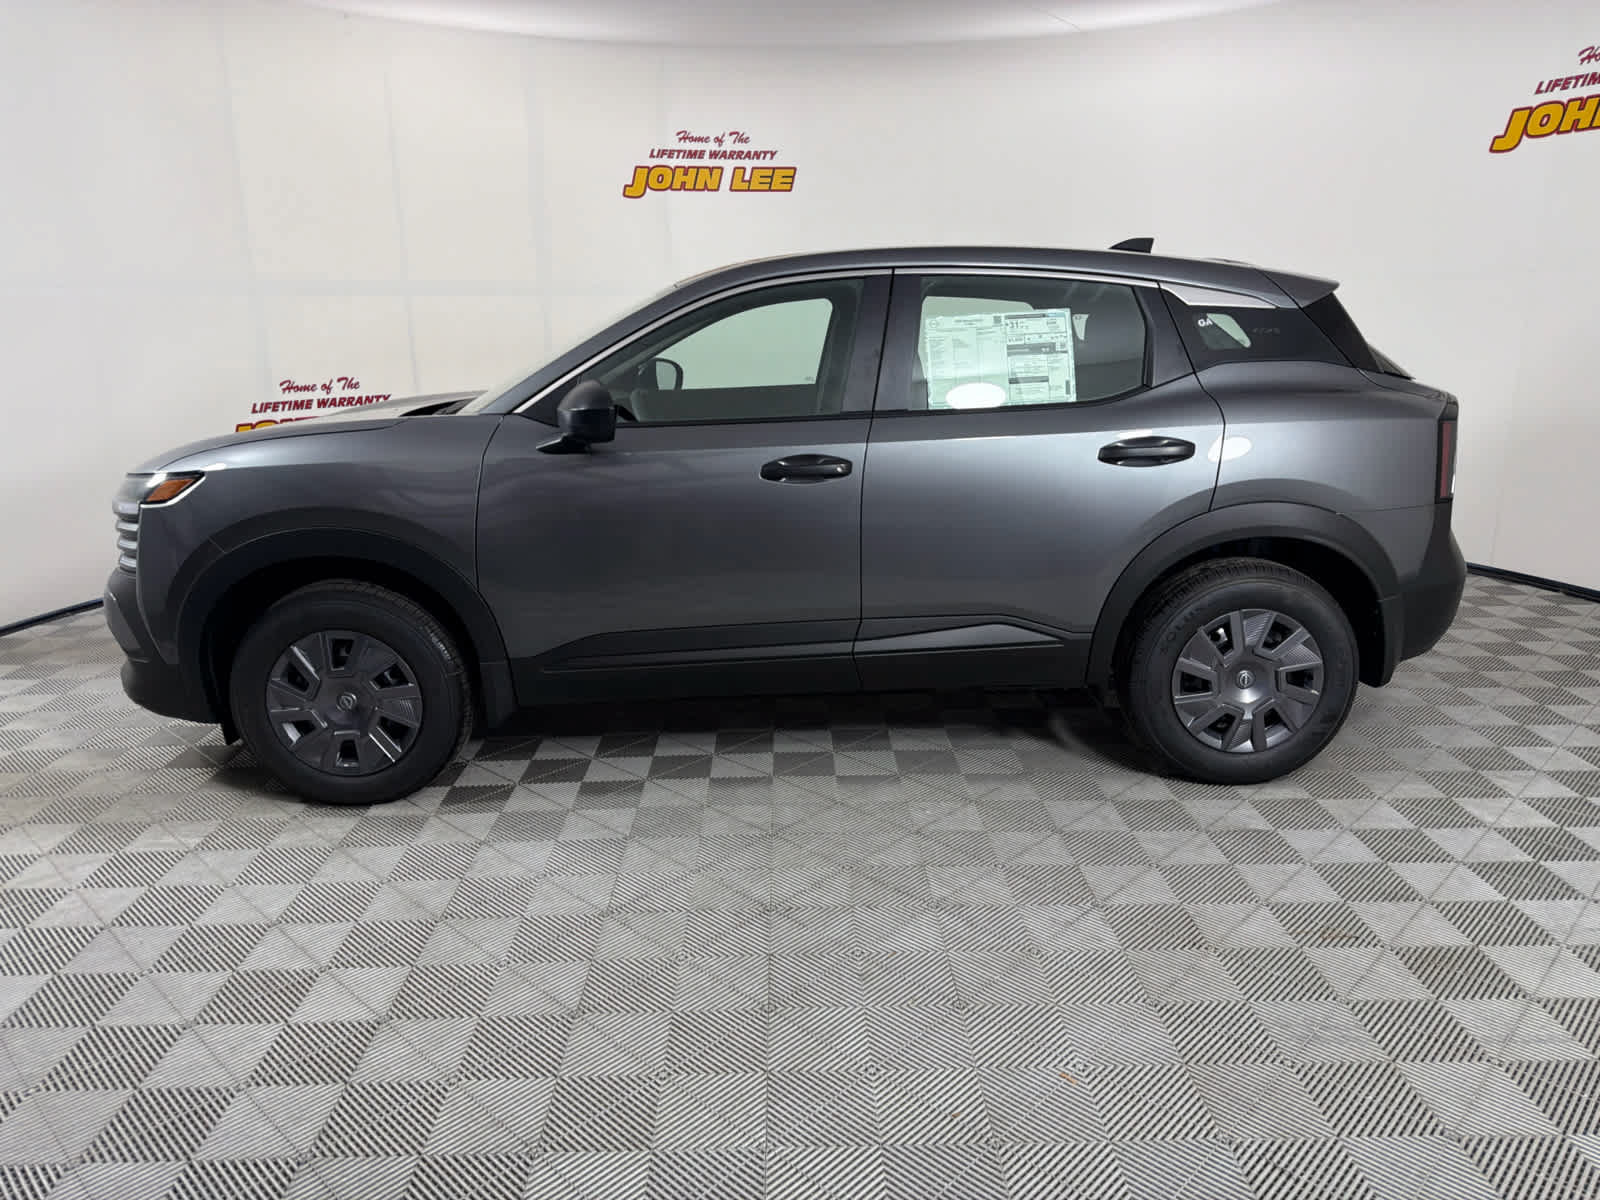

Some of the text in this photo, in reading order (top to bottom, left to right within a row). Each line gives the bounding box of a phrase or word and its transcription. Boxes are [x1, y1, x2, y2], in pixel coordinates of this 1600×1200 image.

[1534, 72, 1600, 95] LIFETIM
[1489, 94, 1600, 154] JOH
[676, 130, 750, 147] Home of The
[649, 149, 778, 160] LIFETIME WARRANTY
[623, 165, 797, 199] JOHN LEE
[279, 377, 360, 395] Home of The
[251, 394, 391, 414] LIFETIME WARRANTY
